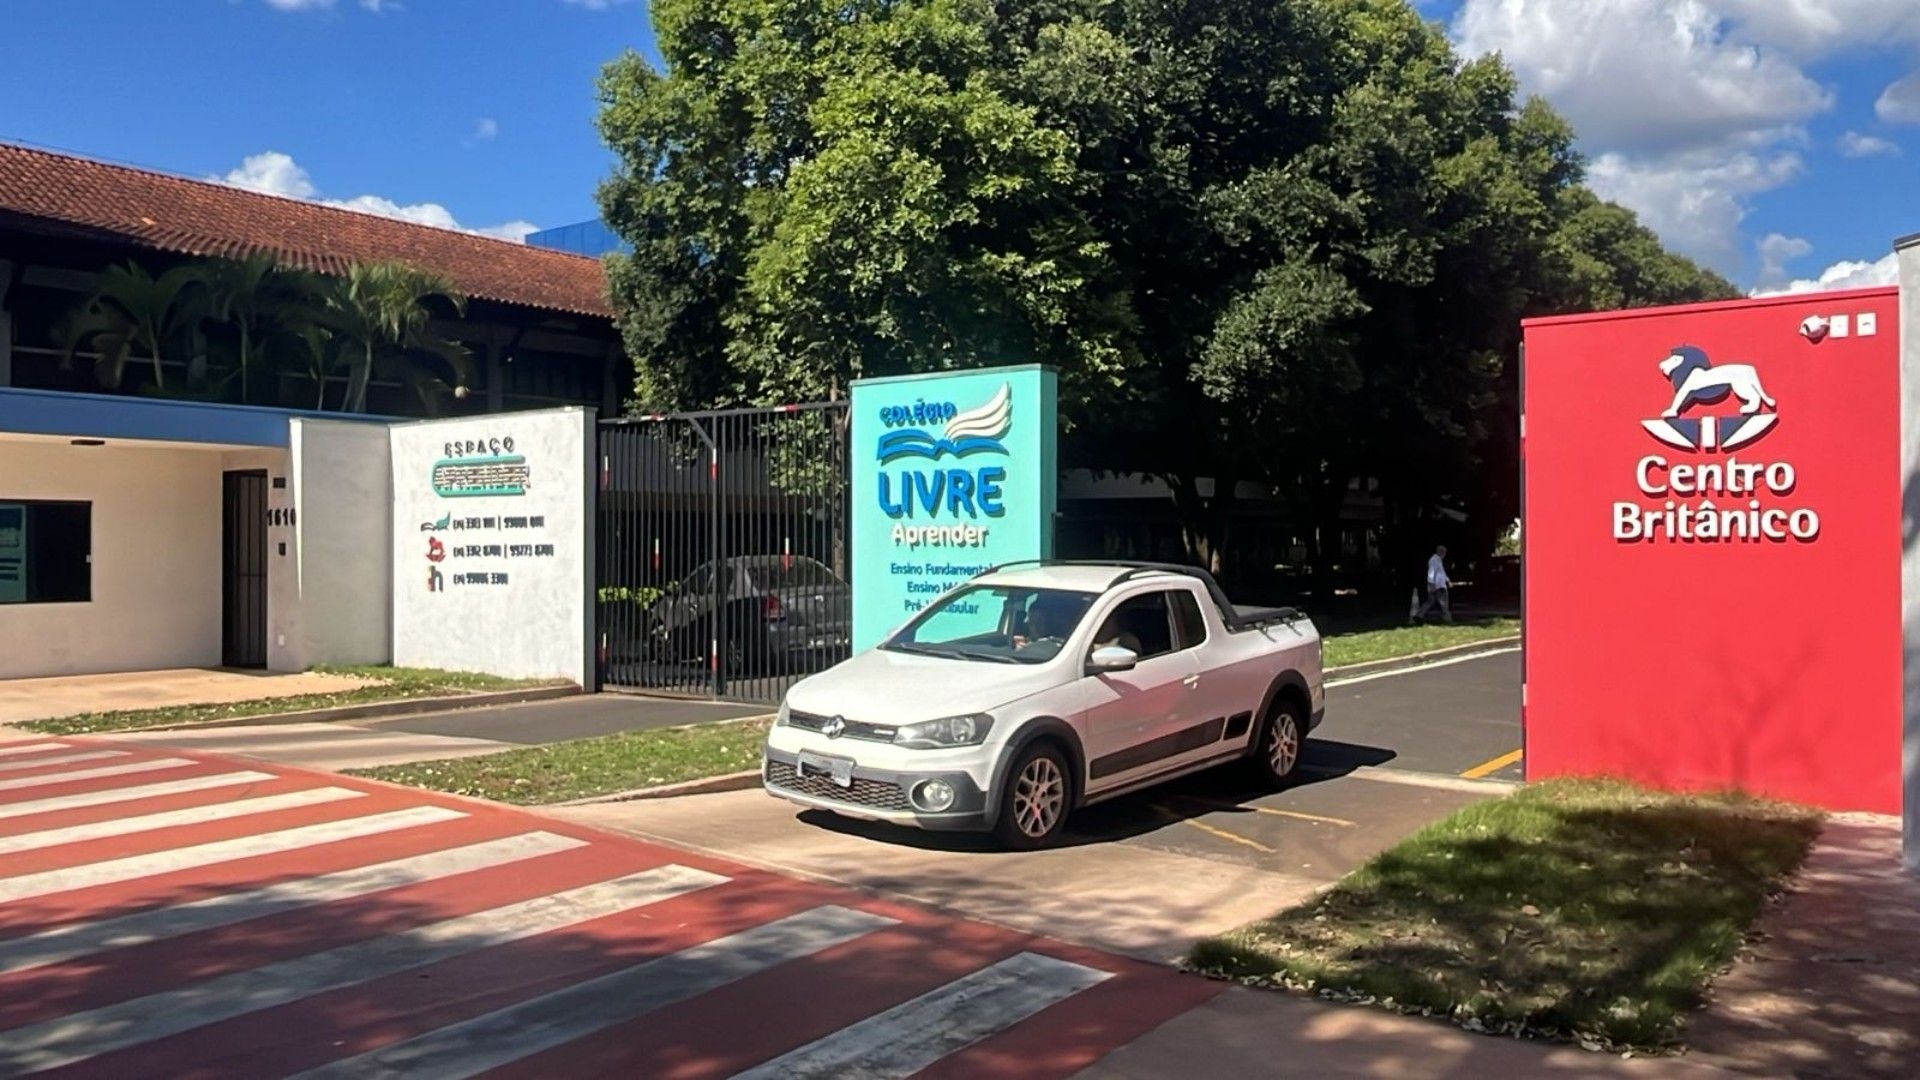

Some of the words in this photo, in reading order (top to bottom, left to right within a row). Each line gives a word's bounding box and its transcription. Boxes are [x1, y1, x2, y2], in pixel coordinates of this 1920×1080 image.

[880, 399, 956, 426] COLÉGIO
[444, 436, 514, 458] ESPAÇO
[1636, 455, 1795, 494] Centro
[878, 467, 1004, 516] LIVRE
[1613, 500, 1819, 540] Britânico
[892, 523, 987, 547] Aprender
[891, 563, 922, 575] Ensino
[907, 581, 940, 593] Ensino
